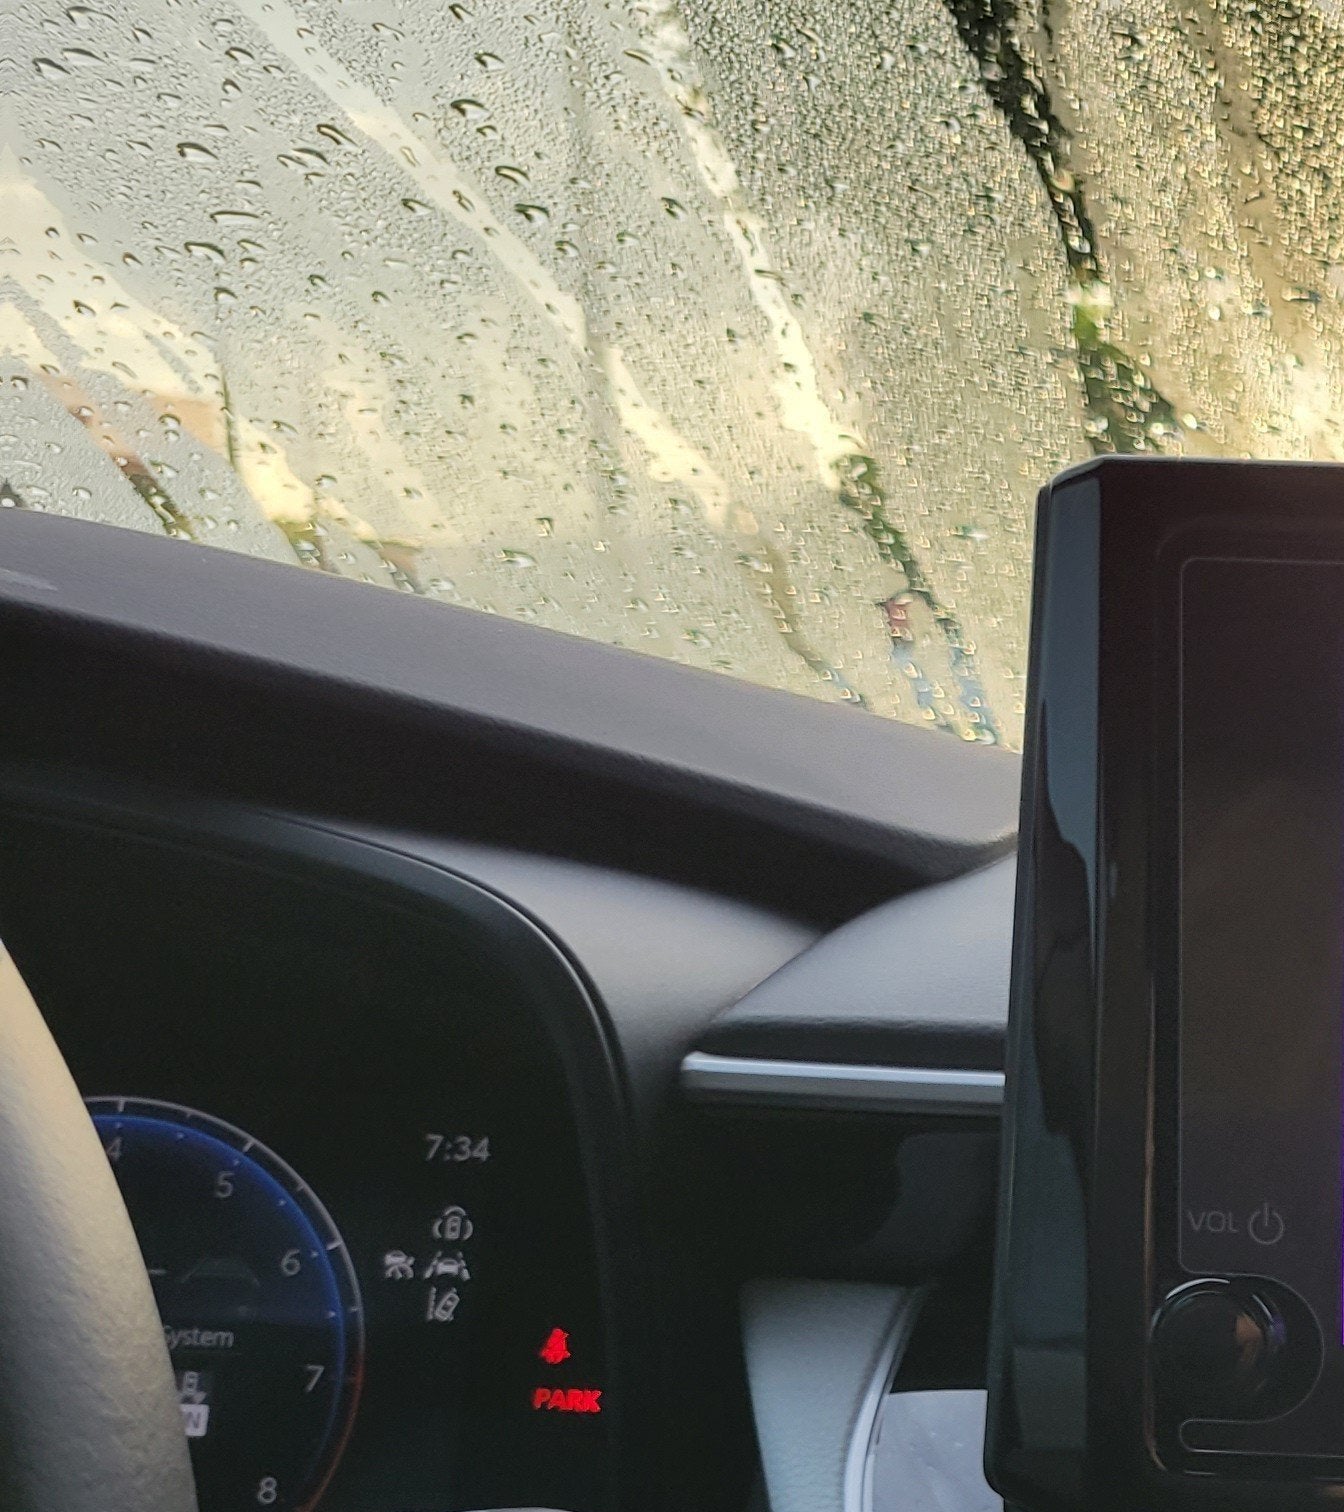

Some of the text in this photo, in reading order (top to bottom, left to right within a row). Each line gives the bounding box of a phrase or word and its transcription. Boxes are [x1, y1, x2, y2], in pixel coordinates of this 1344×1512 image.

[106, 1137, 122, 1161] 4
[425, 1134, 491, 1162] 7:34
[214, 1171, 236, 1198] 5
[1186, 1210, 1240, 1233] VOL
[280, 1249, 302, 1277] 6
[306, 1364, 325, 1392] 7
[533, 1388, 602, 1413] PARK
[257, 1476, 278, 1504] 8
